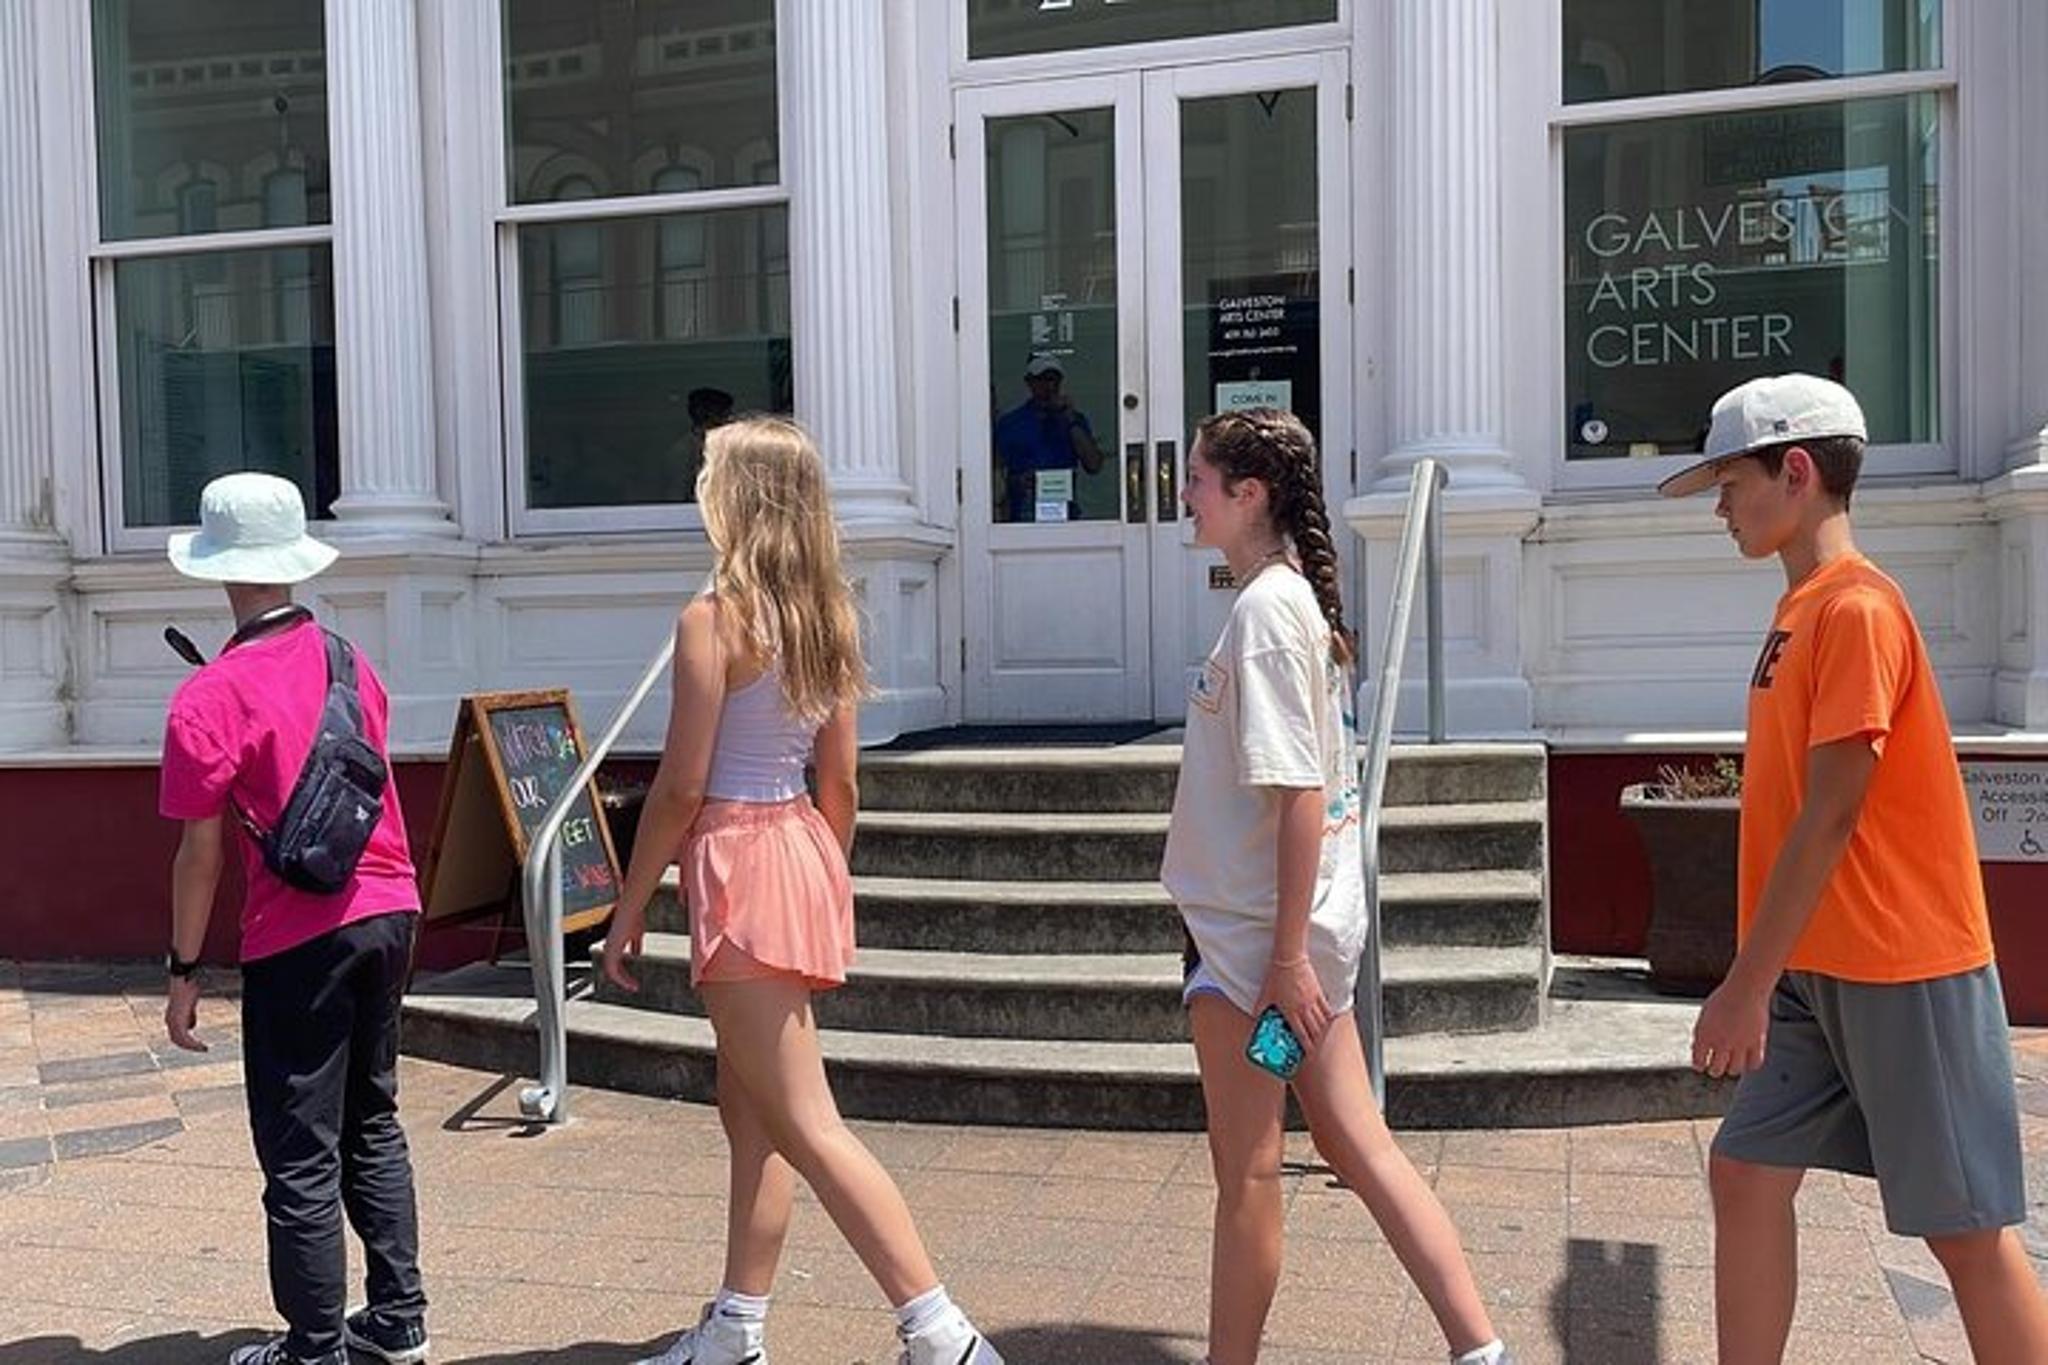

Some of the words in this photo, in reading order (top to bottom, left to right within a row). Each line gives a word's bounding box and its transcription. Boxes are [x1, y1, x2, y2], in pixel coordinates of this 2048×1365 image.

[1586, 194, 1909, 257] GALVESO
[1220, 296, 1286, 310] GALVESTON
[1587, 262, 1716, 313] ARTS
[1245, 308, 1285, 323] CENTER
[1587, 313, 1793, 368] CENTER
